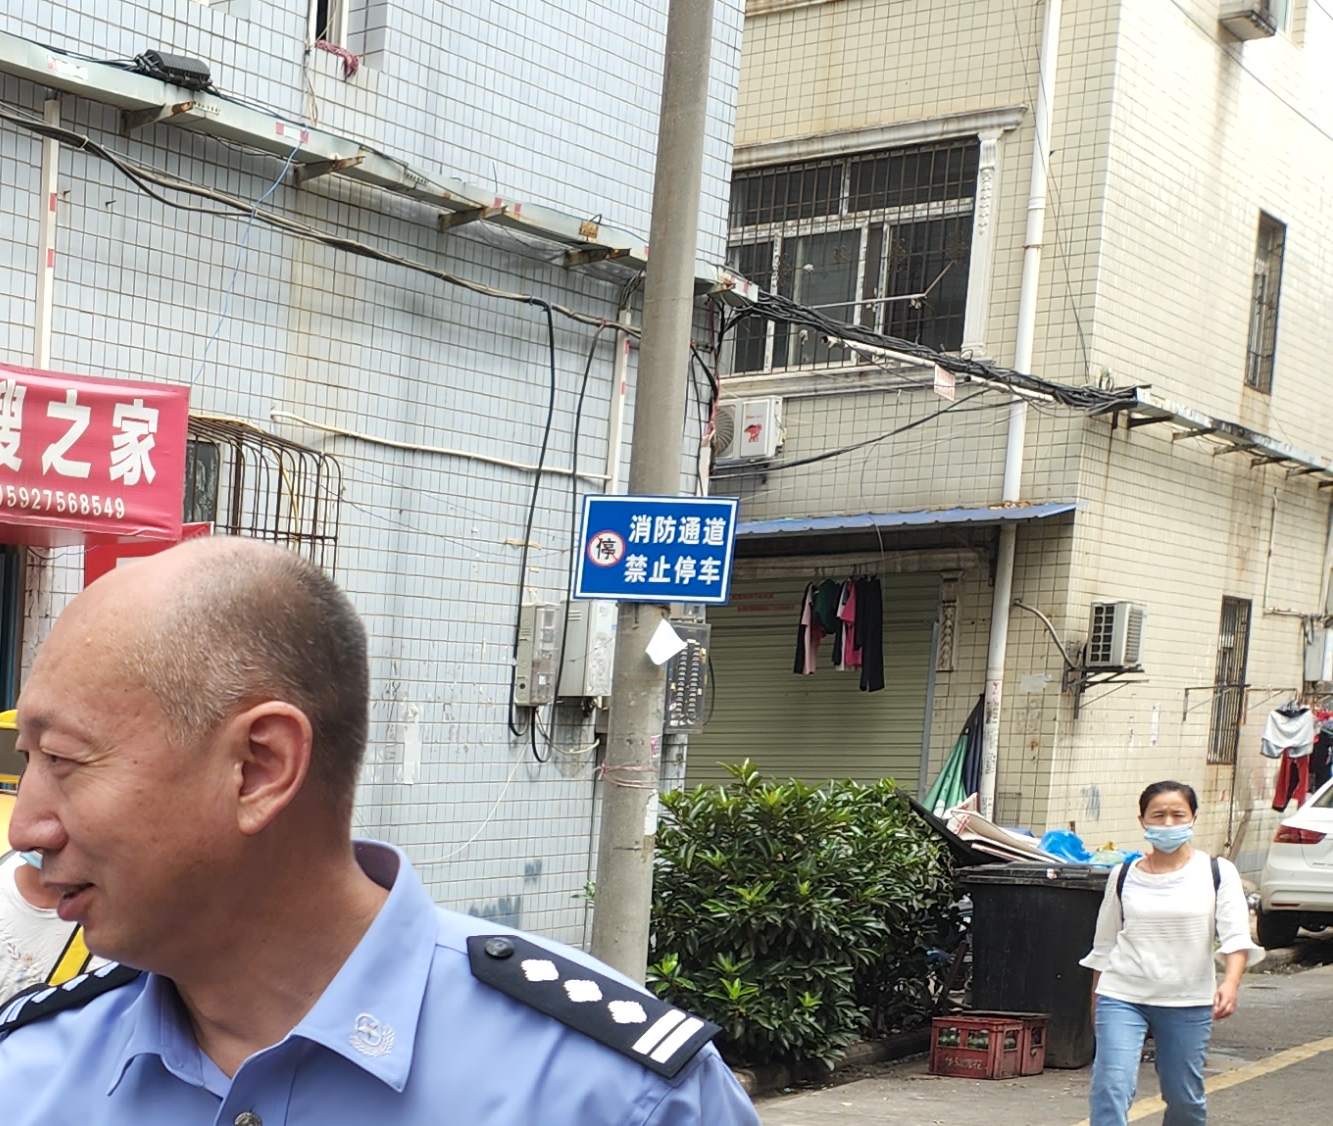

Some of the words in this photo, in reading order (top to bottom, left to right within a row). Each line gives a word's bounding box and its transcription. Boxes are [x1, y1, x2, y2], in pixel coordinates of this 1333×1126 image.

[628, 513, 727, 546] 消防通道
[596, 537, 617, 560] 停
[623, 553, 722, 585] 禁止停车
